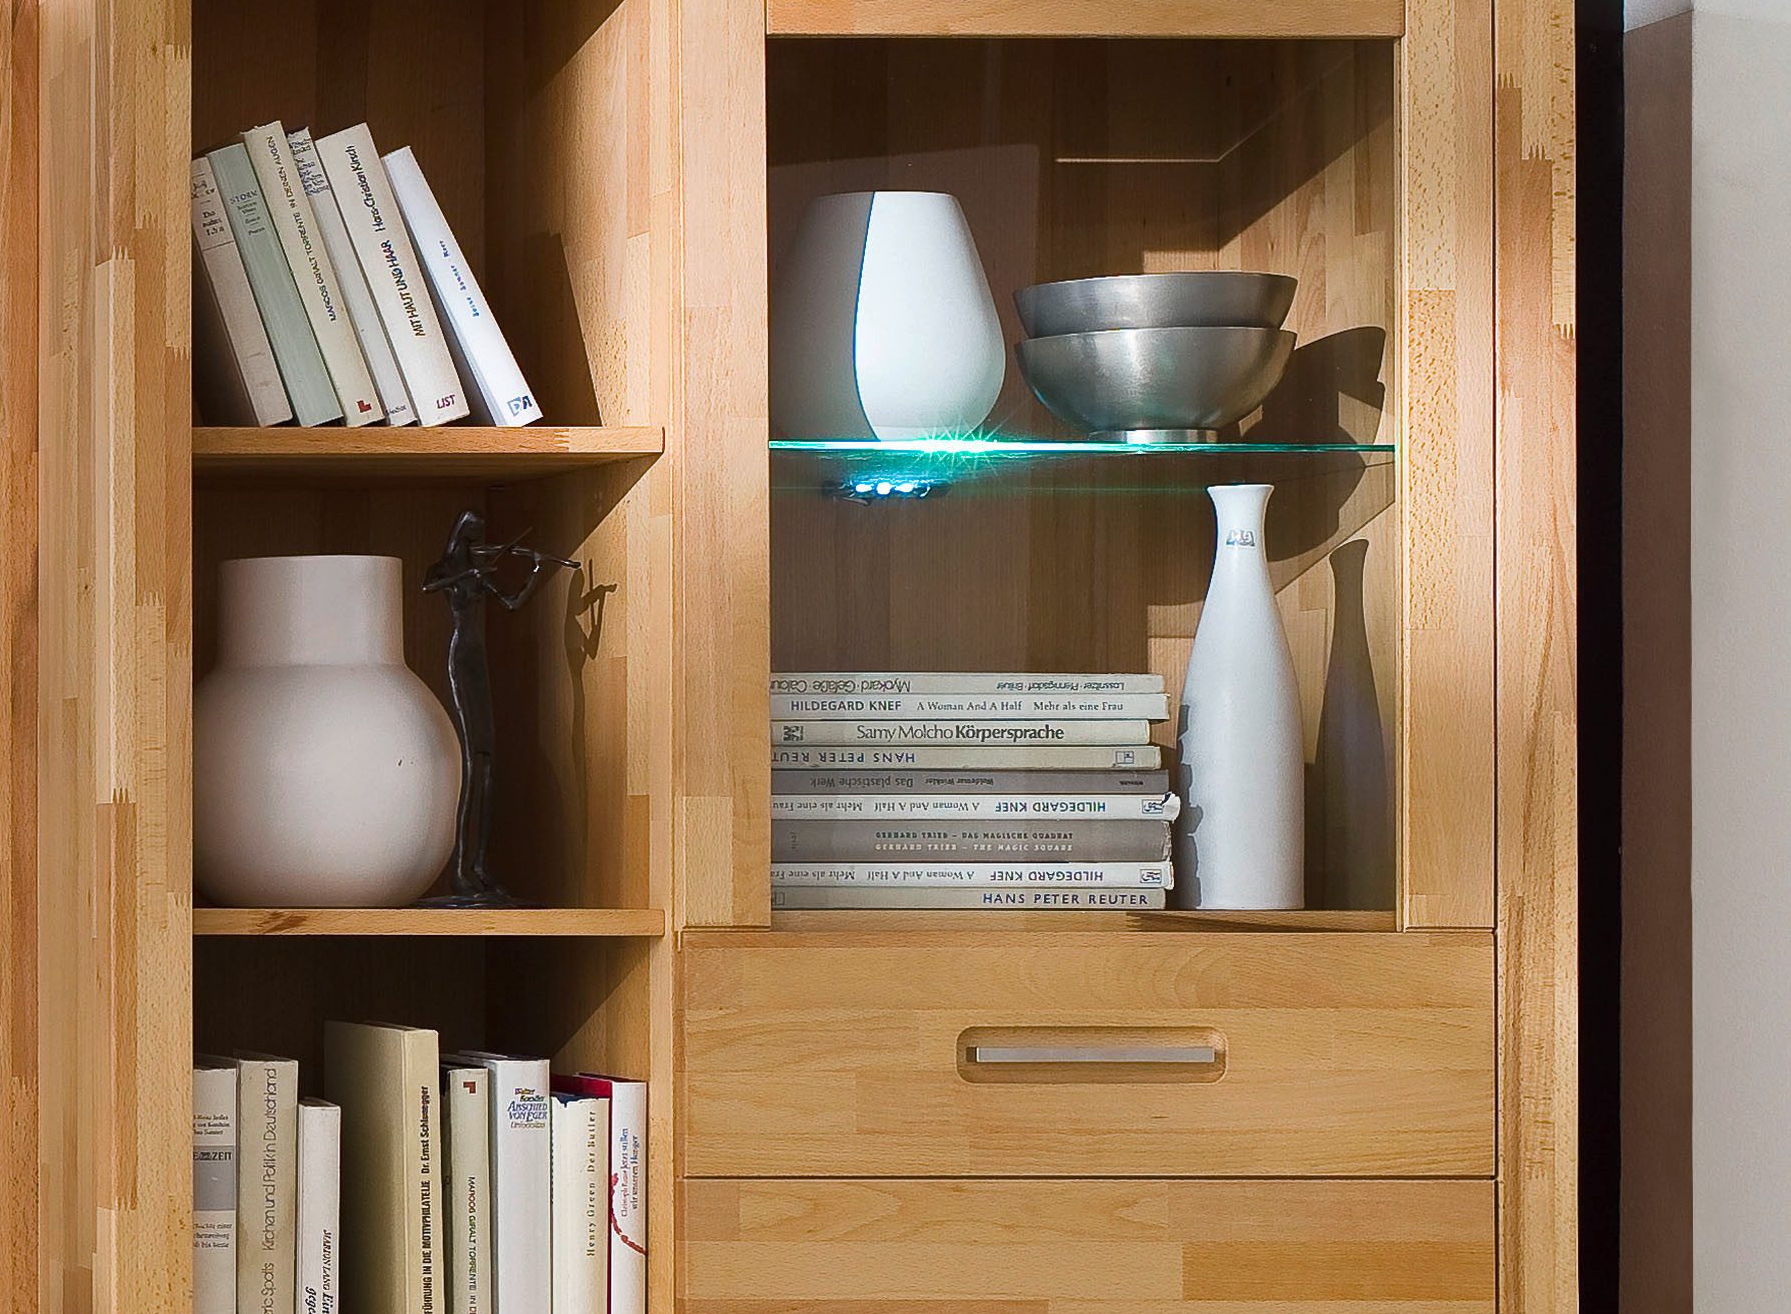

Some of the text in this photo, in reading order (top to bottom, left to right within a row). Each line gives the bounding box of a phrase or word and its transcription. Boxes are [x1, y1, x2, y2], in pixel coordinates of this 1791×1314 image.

[380, 238, 398, 269] HAAR
[391, 268, 409, 292] UND
[399, 291, 419, 319] HAUT
[410, 318, 426, 337] MIT
[436, 394, 456, 409] LIST
[791, 699, 1124, 711] HILDEGARD KNEF A Woman And A Half Mehr als eine Frau
[857, 724, 1065, 744] Samy Molcho Körpersprache
[818, 752, 865, 763] PETER
[872, 752, 915, 763] HANS
[809, 776, 914, 789] Das plastische Werk
[819, 801, 835, 813] als
[837, 801, 863, 813] Mehr
[873, 801, 896, 813] Half
[898, 801, 907, 813] A
[909, 801, 930, 813] And
[933, 801, 969, 813] Woman
[972, 801, 980, 813] A
[994, 801, 1028, 813] KNEF
[1033, 801, 1106, 813] HILDEGARD
[811, 869, 826, 882] als
[828, 869, 856, 882] Mehr
[866, 869, 889, 882] Half
[891, 869, 900, 882] A
[902, 869, 923, 882] And
[926, 869, 963, 882] Woman
[966, 869, 975, 882] A
[989, 869, 1023, 882] KNEF
[1028, 869, 1104, 882] HILDEGARD
[983, 893, 1148, 905] HANS PETER REUTER
[264, 1068, 278, 1141] Deutschland
[212, 1151, 233, 1161] ZEIT
[420, 1139, 430, 1161] Ernst
[420, 1162, 430, 1174] Dr.
[586, 1152, 595, 1173] Der
[262, 1184, 277, 1209] und
[420, 1180, 432, 1249] MOTIVPHILATELIE
[586, 1182, 596, 1257] Henry Green
[421, 1249, 432, 1264] DIE
[421, 1265, 432, 1275] IN
[261, 1263, 275, 1296] Spotts
[321, 1293, 334, 1314] Ein
